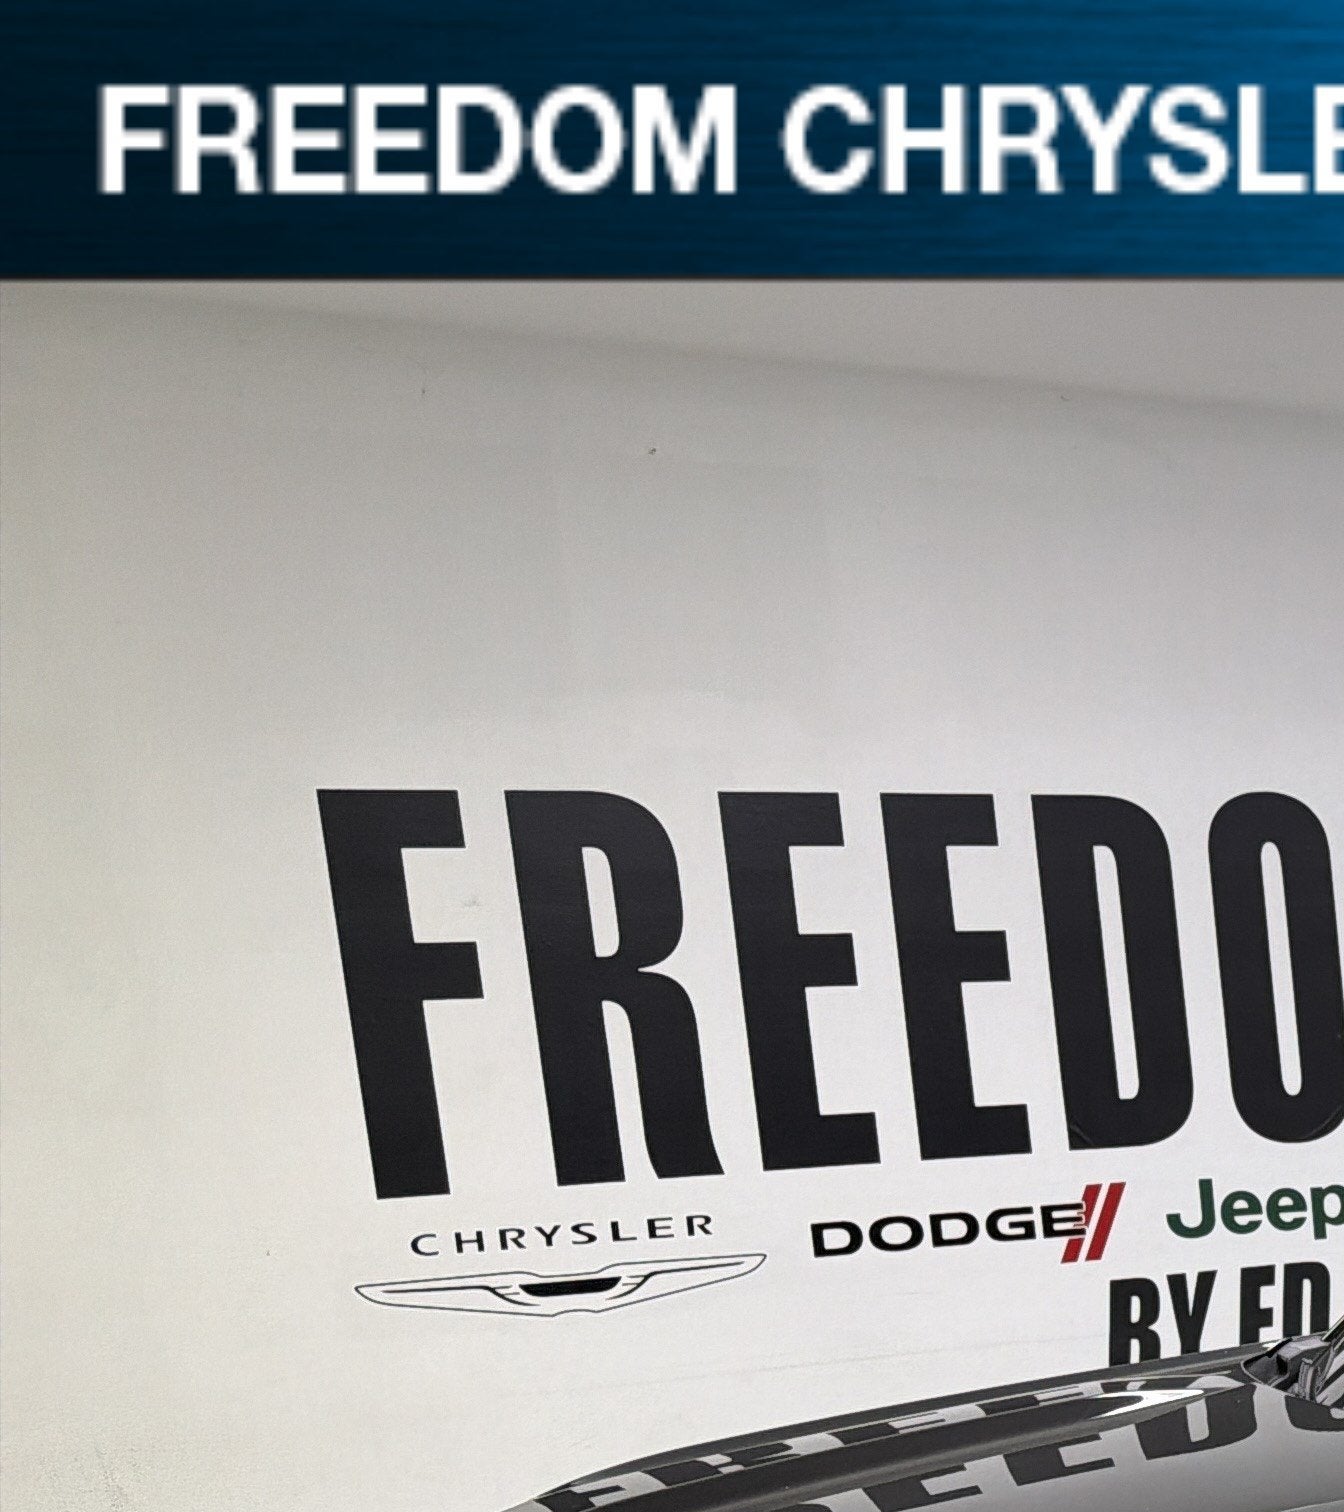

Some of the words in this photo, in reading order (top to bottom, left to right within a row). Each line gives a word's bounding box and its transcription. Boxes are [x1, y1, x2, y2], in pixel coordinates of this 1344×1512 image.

[410, 1215, 713, 1257] CHRYSLER
[811, 1203, 1087, 1259] DODGE
[1109, 1269, 1218, 1367] BY
[1239, 1261, 1330, 1345] ED
